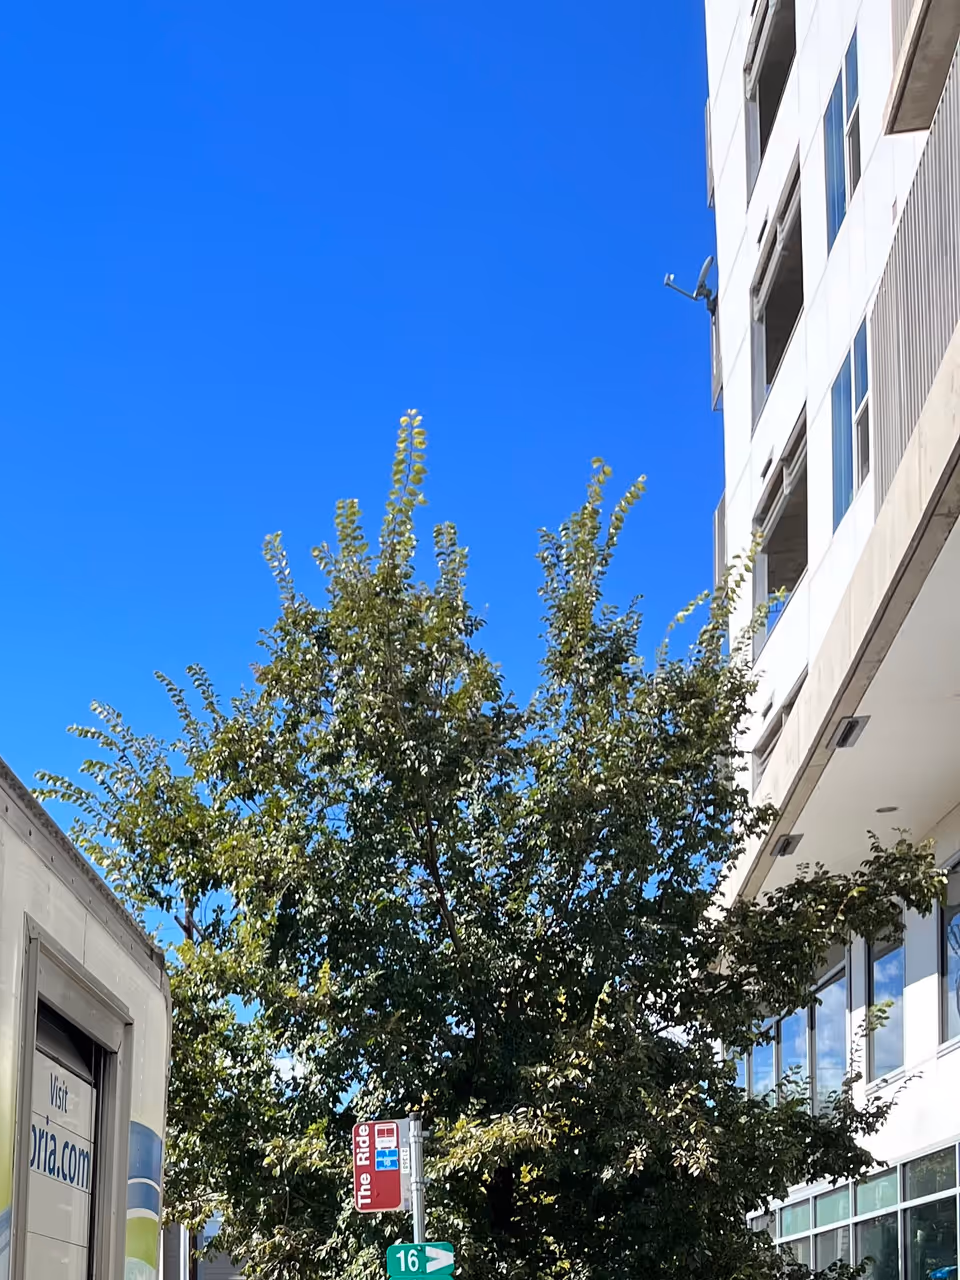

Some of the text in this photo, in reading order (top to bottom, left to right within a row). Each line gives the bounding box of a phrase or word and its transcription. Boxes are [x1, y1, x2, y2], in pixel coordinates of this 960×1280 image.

[49, 1072, 69, 1114] Visit
[355, 1124, 372, 1208] The Ride
[395, 1248, 420, 1272] 16
